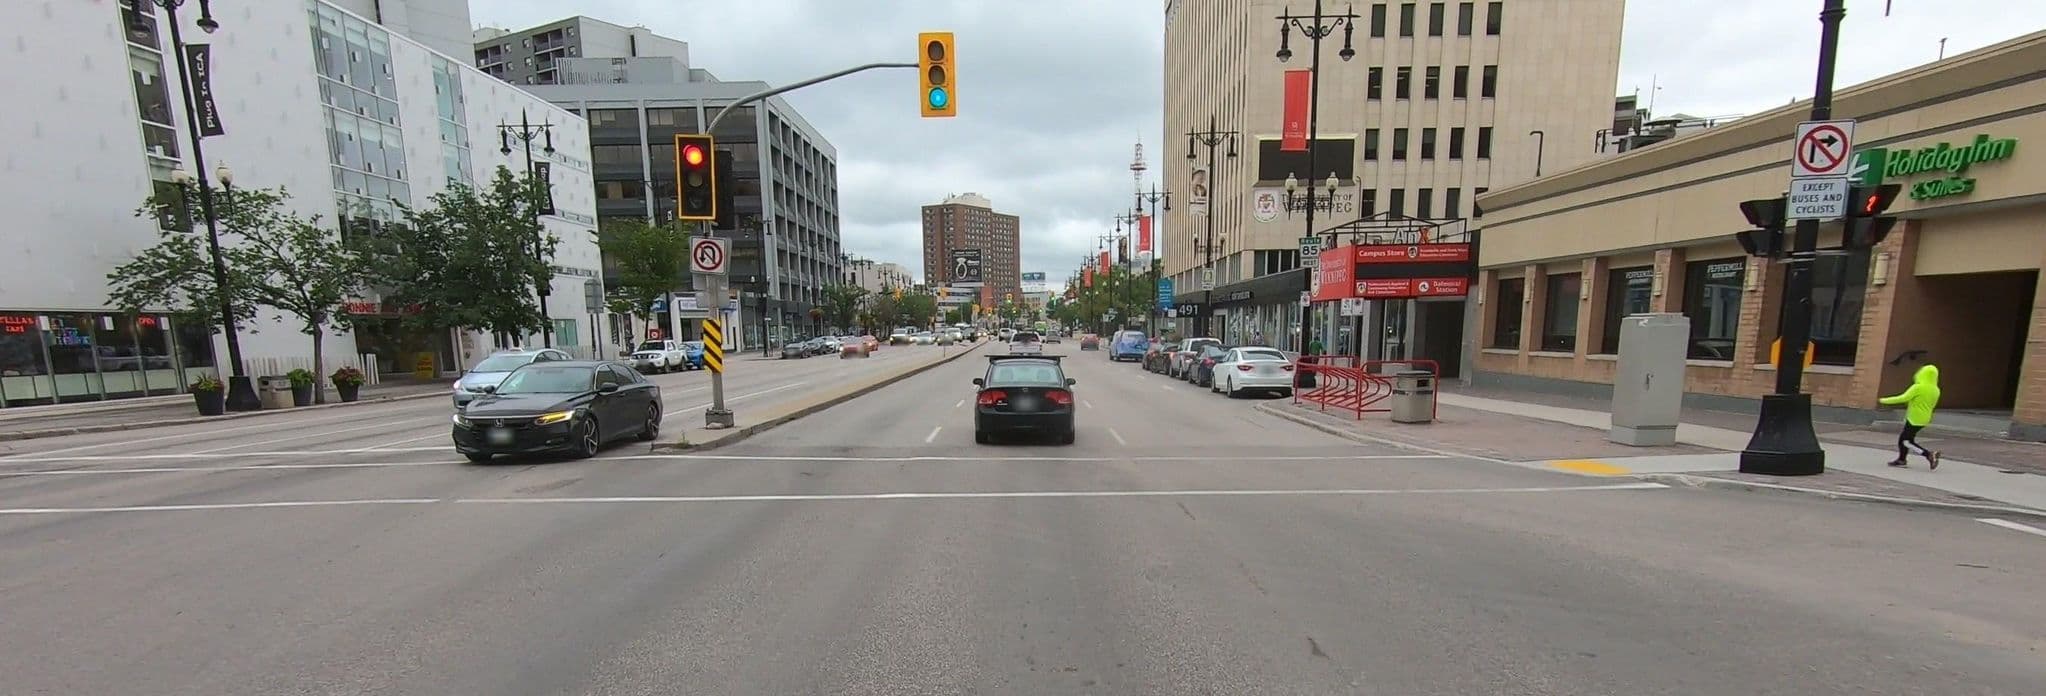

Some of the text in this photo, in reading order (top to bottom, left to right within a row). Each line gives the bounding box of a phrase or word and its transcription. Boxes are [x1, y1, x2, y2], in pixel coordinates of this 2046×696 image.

[195, 52, 205, 77] ICA
[205, 100, 216, 128] Plug
[1883, 134, 2015, 178] Holiday Inn
[1802, 183, 1834, 192] EXCEPT
[1922, 177, 1974, 199] Suites
[1791, 193, 1843, 204] BUSES AND
[1795, 204, 1836, 214] CYCLISTS
[1302, 245, 1319, 256] 85
[1359, 248, 1405, 259] Campus Store
[1178, 304, 1199, 315] 491
